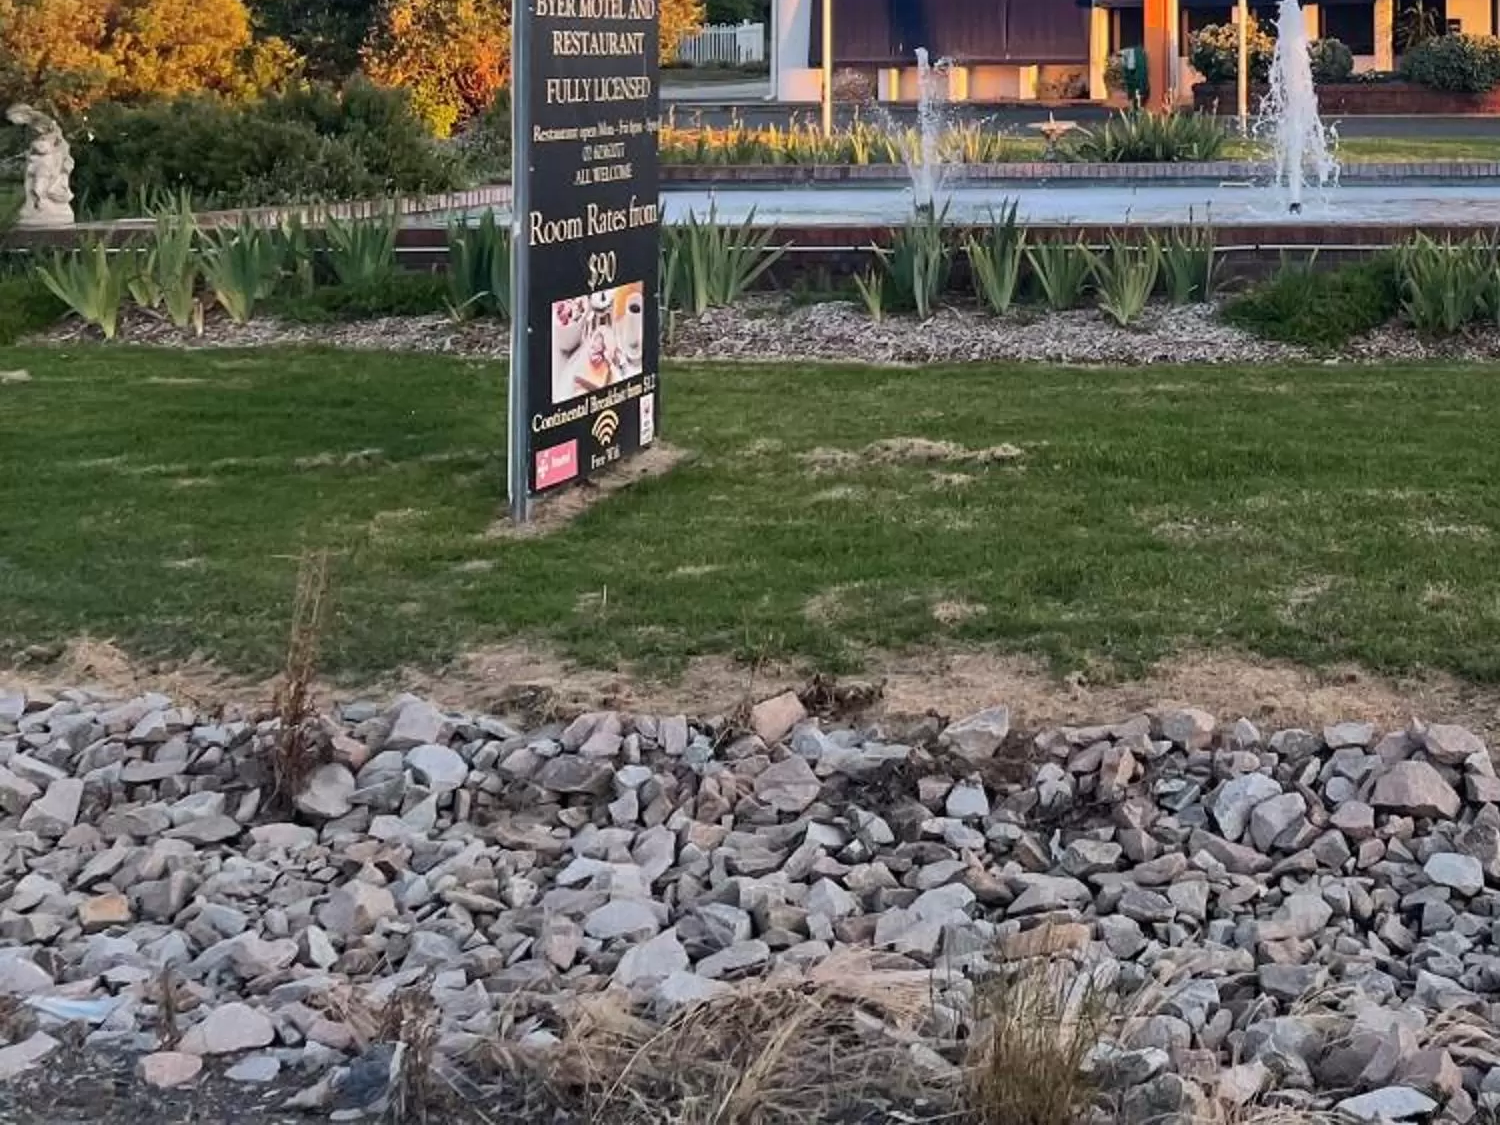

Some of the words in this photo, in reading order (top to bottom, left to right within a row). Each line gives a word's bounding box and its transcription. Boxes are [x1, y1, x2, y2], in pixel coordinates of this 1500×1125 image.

[552, 30, 645, 56] RESTAURANT
[547, 76, 594, 104] FULLY
[594, 75, 651, 102] LICENSED
[528, 210, 584, 246] Room
[586, 202, 627, 236] Rates
[629, 194, 658, 228] from
[587, 250, 617, 292] $90
[532, 396, 589, 433] Continental
